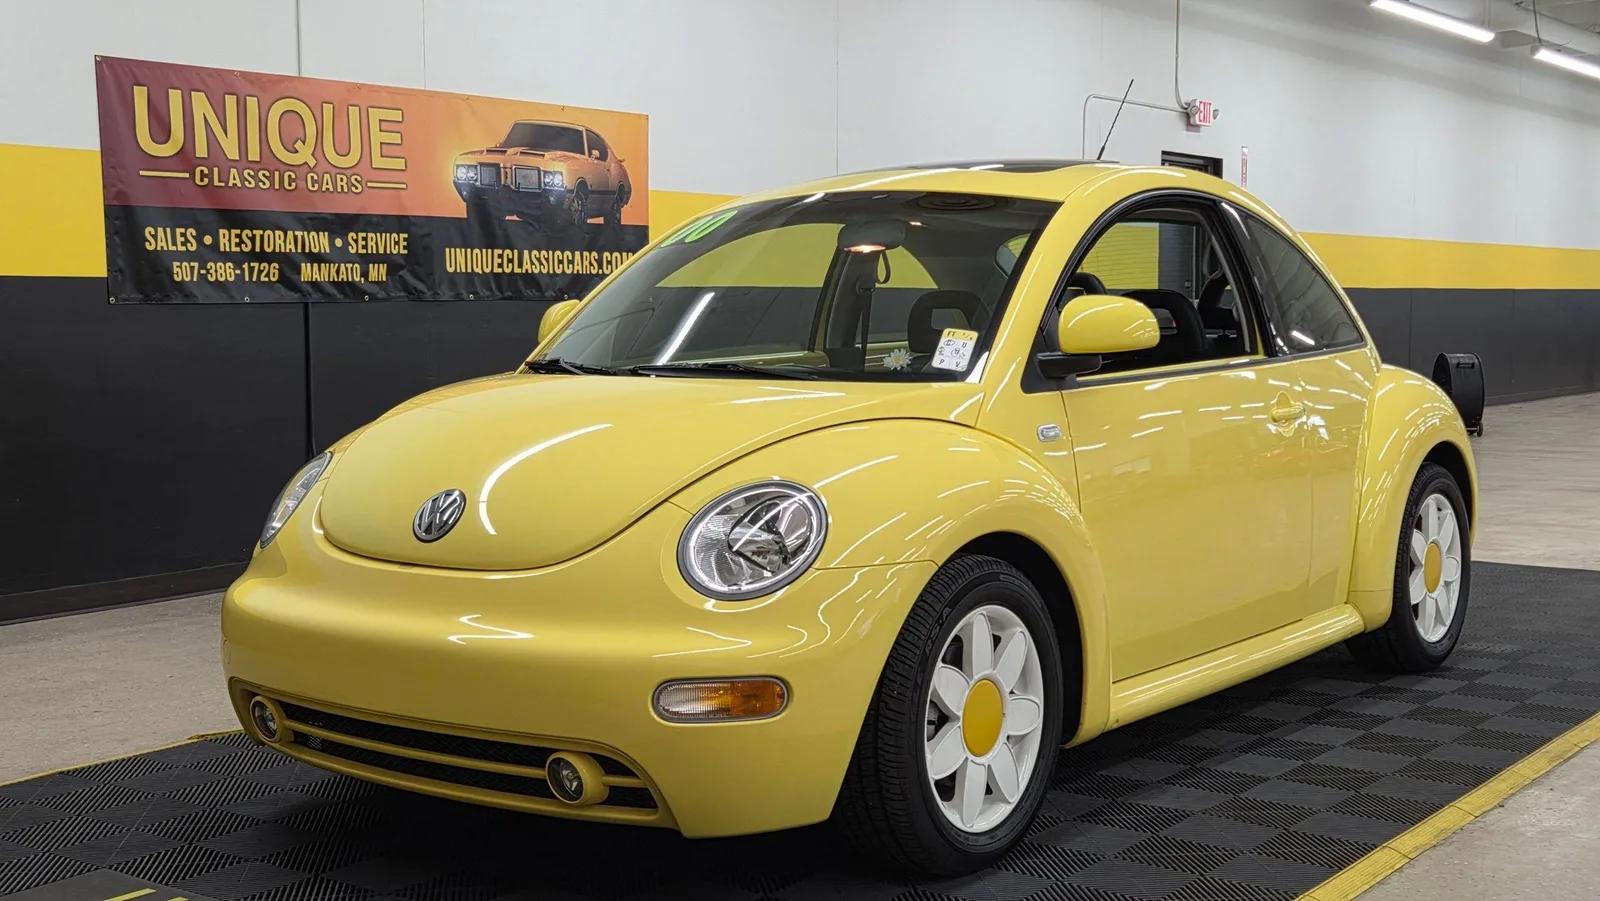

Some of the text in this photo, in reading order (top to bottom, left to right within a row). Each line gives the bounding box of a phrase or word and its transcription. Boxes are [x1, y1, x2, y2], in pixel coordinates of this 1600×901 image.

[1198, 101, 1212, 123] EXIT
[133, 85, 407, 170] UNIQUE
[194, 166, 363, 193] CLASSIC CARS
[144, 226, 409, 255] SALES RESTORATION SERVICE
[172, 261, 388, 284] 507-386-1726 MANKATO, MN
